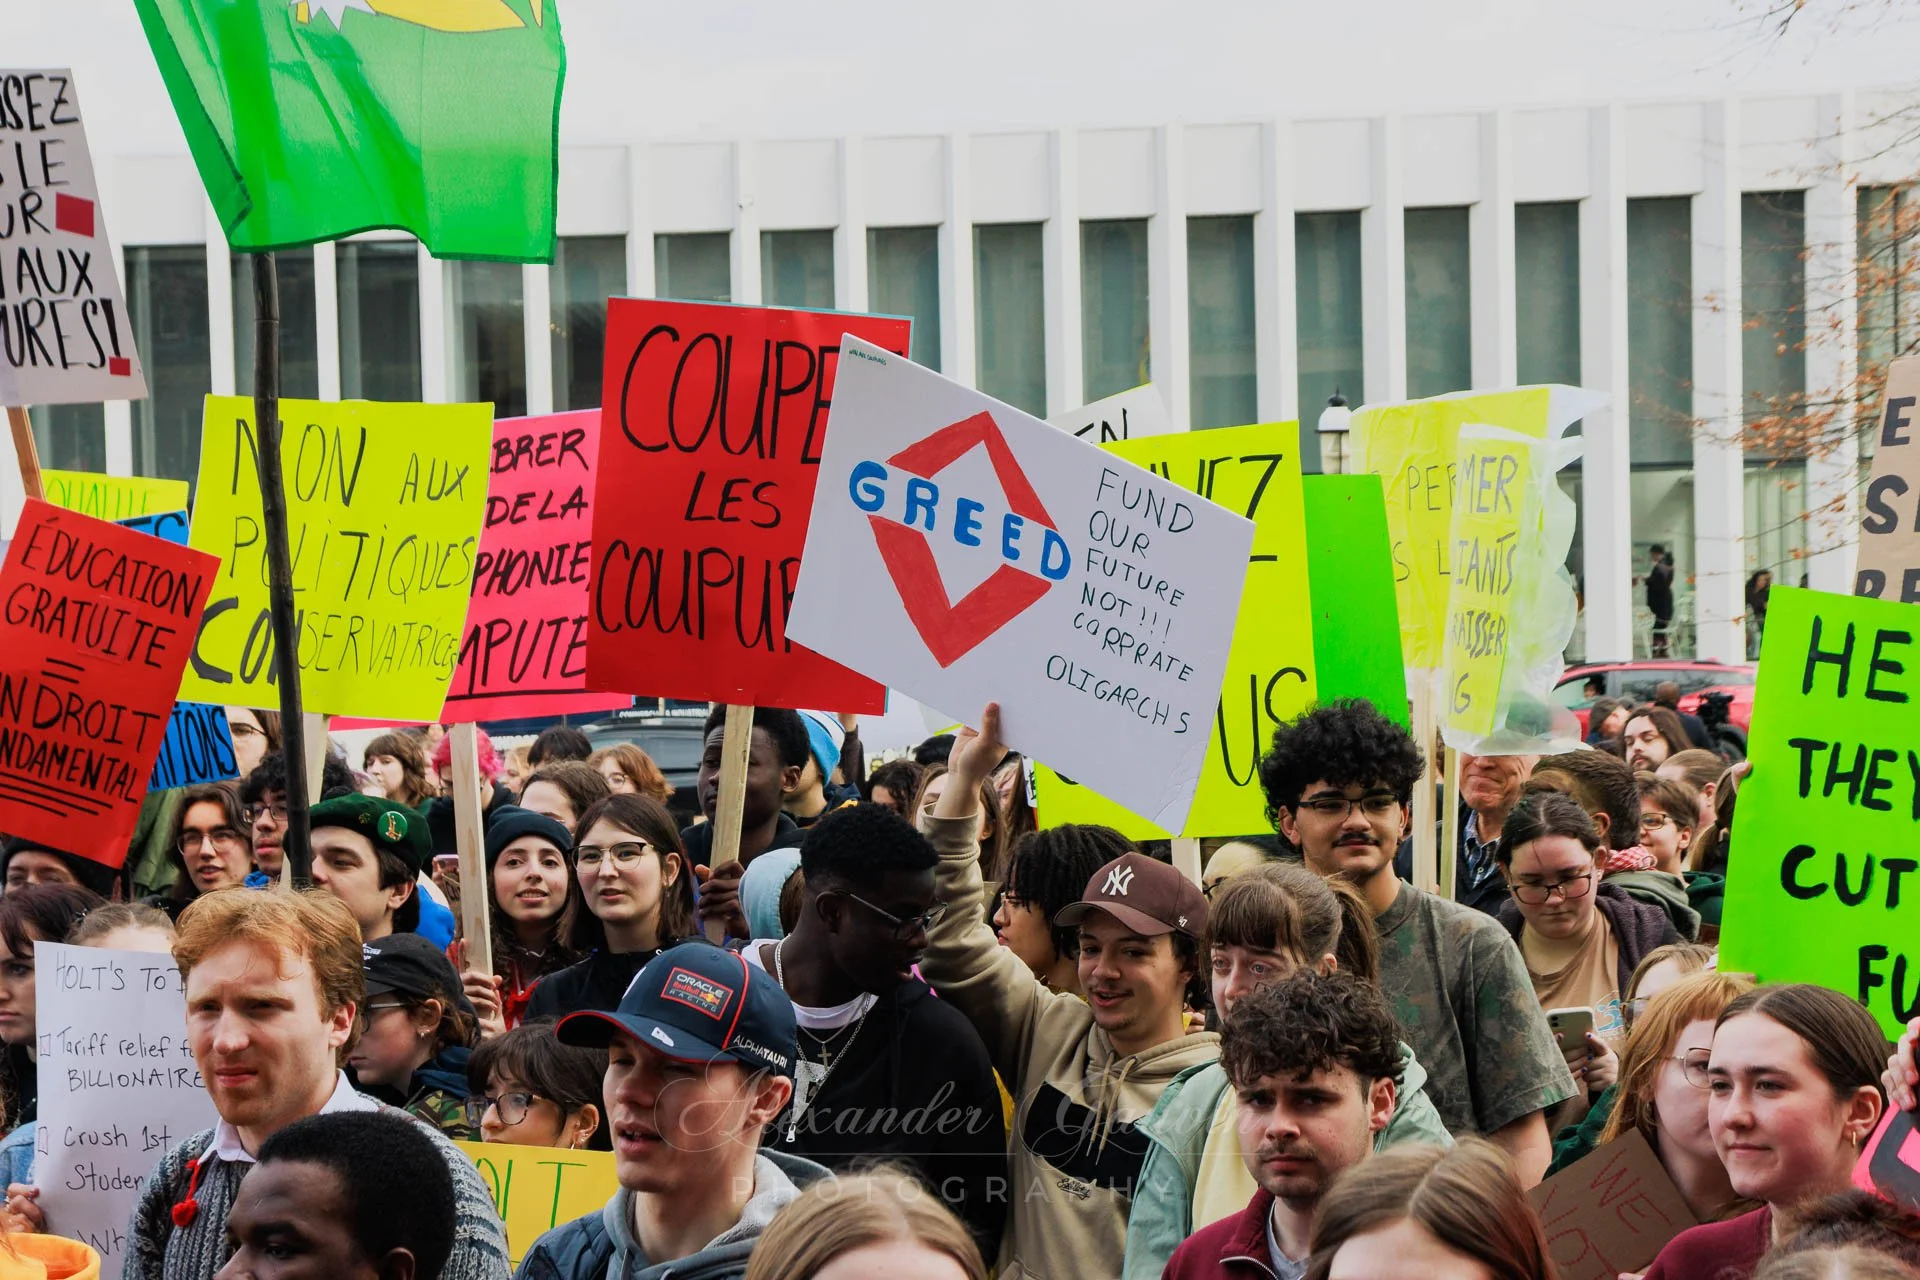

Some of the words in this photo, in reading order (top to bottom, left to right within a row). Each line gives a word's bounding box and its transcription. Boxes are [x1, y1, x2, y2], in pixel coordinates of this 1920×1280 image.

[16, 247, 94, 298] AUX
[620, 325, 903, 465] COUPE
[399, 452, 470, 504] AUX
[684, 471, 782, 529] LES
[1096, 468, 1194, 533] FUND
[486, 492, 536, 530] DE
[537, 485, 589, 520] LA
[849, 460, 1072, 581] GREED
[1089, 511, 1150, 560] OUR
[20, 517, 202, 618] ÉDUCATION
[1086, 548, 1185, 607] FUTURE
[5, 582, 177, 669] GRATUITE
[1801, 615, 1912, 704] HE
[32, 684, 161, 753] DROIT
[1046, 655, 1192, 735] OLIGARCHS
[1780, 844, 1918, 910] CUT
[55, 951, 125, 992] HOLT'S
[669, 988, 718, 1013] RACING
[676, 973, 724, 998] ORACLE
[57, 1025, 109, 1057] Tariff
[119, 1033, 171, 1059] relief
[733, 1034, 788, 1069] ALPHATAURI
[141, 1124, 173, 1153] 1st
[1590, 1148, 1673, 1234] WE
